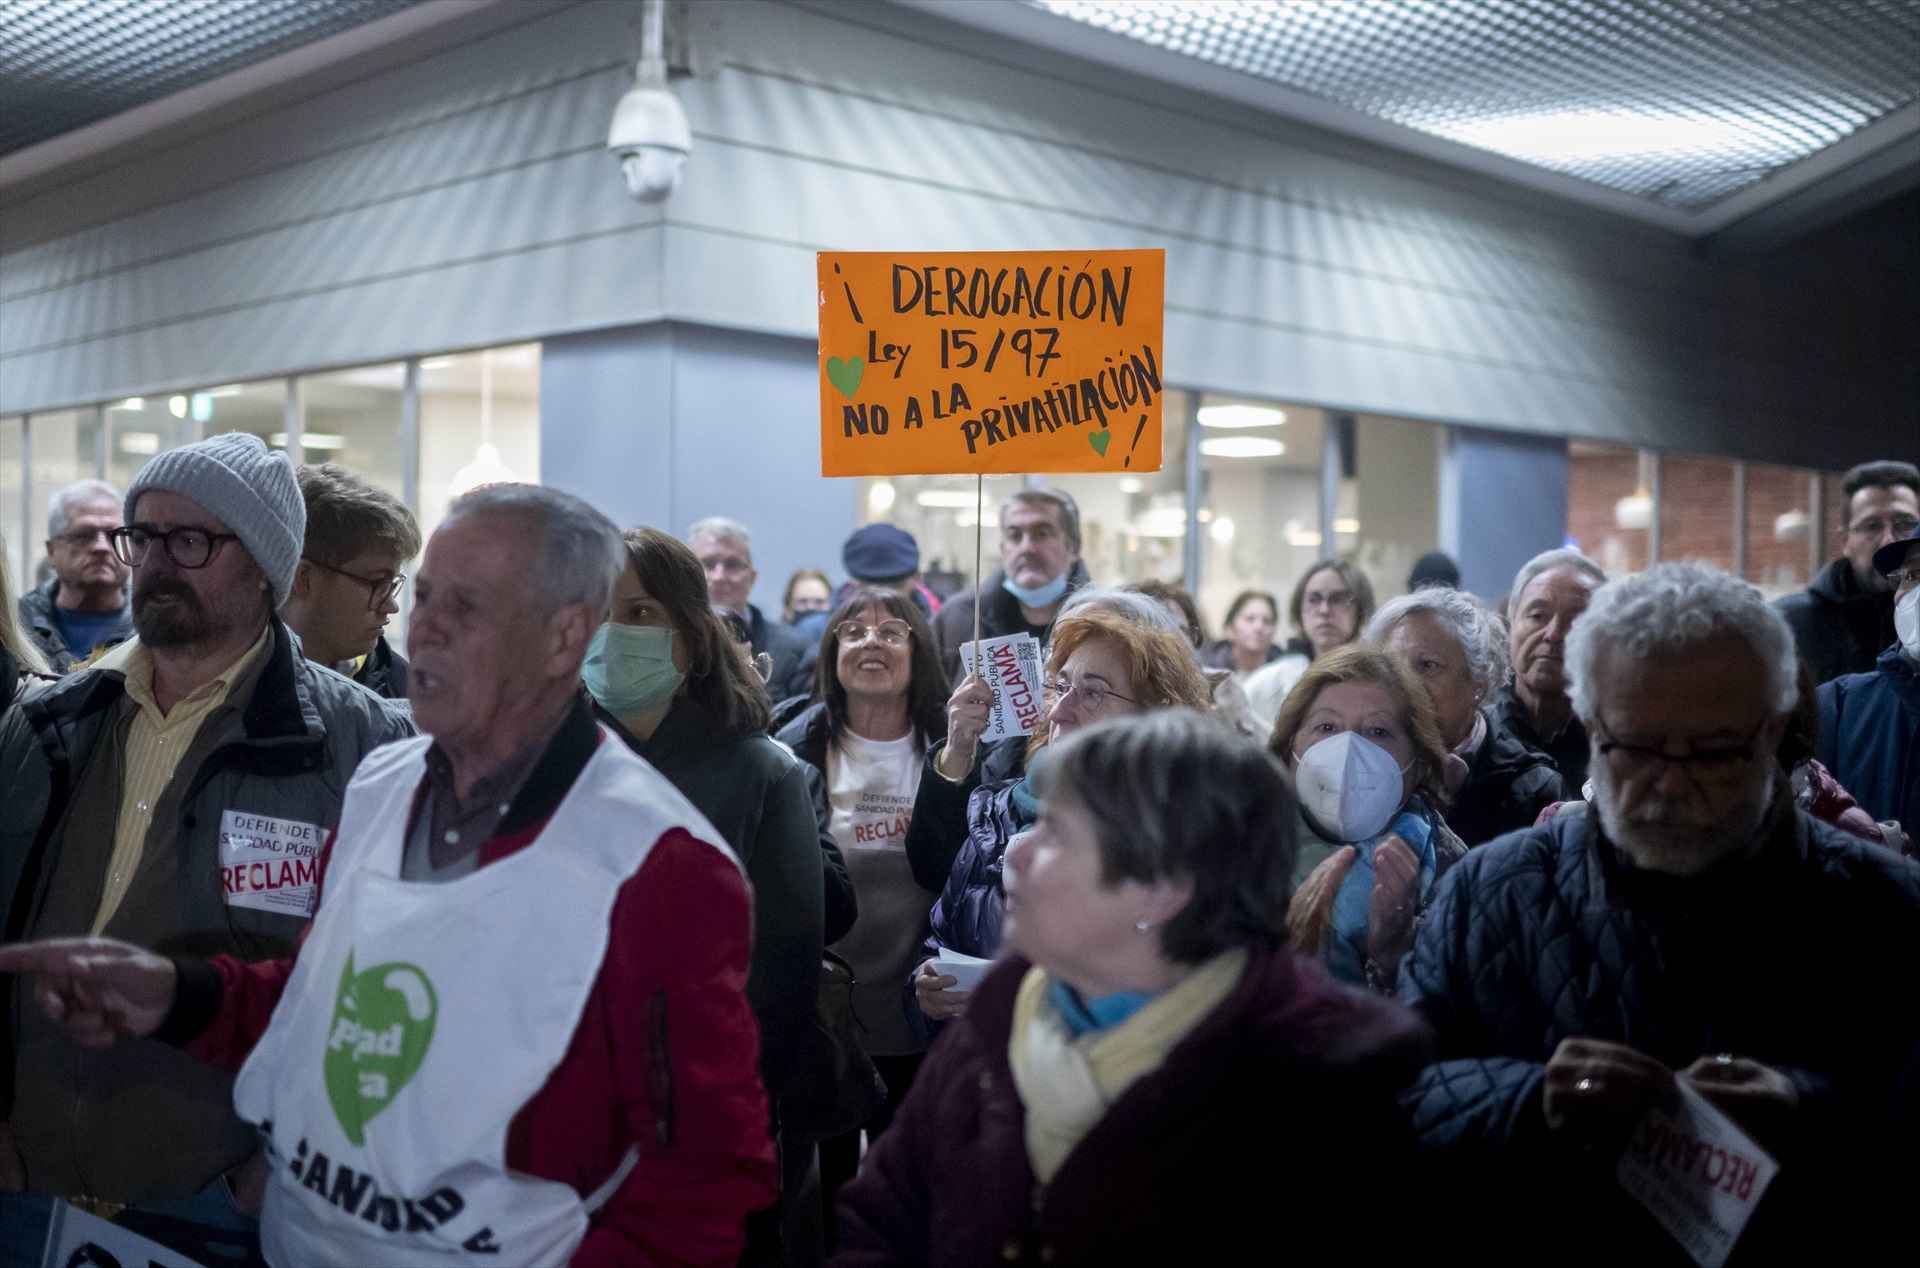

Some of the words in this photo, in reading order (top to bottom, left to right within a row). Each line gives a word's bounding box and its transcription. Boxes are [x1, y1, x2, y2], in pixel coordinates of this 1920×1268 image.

[892, 259, 1131, 326] DEROGACIÓN
[868, 330, 912, 379] Ley
[940, 327, 1062, 378] 15/97
[843, 402, 889, 438] NO
[904, 396, 923, 429] A
[931, 382, 972, 419] LA
[960, 344, 1163, 454] PRIVATIZACIÓN
[987, 646, 1000, 687] PÚBLICA
[993, 644, 1039, 730] RECLAMA
[992, 689, 1005, 734] SANIDAD
[854, 804, 895, 815] SANIDAD
[862, 793, 912, 804] DEFIENDE
[234, 816, 311, 840] DEFIENDE
[285, 841, 319, 858] PÚBL
[220, 855, 318, 894] RECLAM
